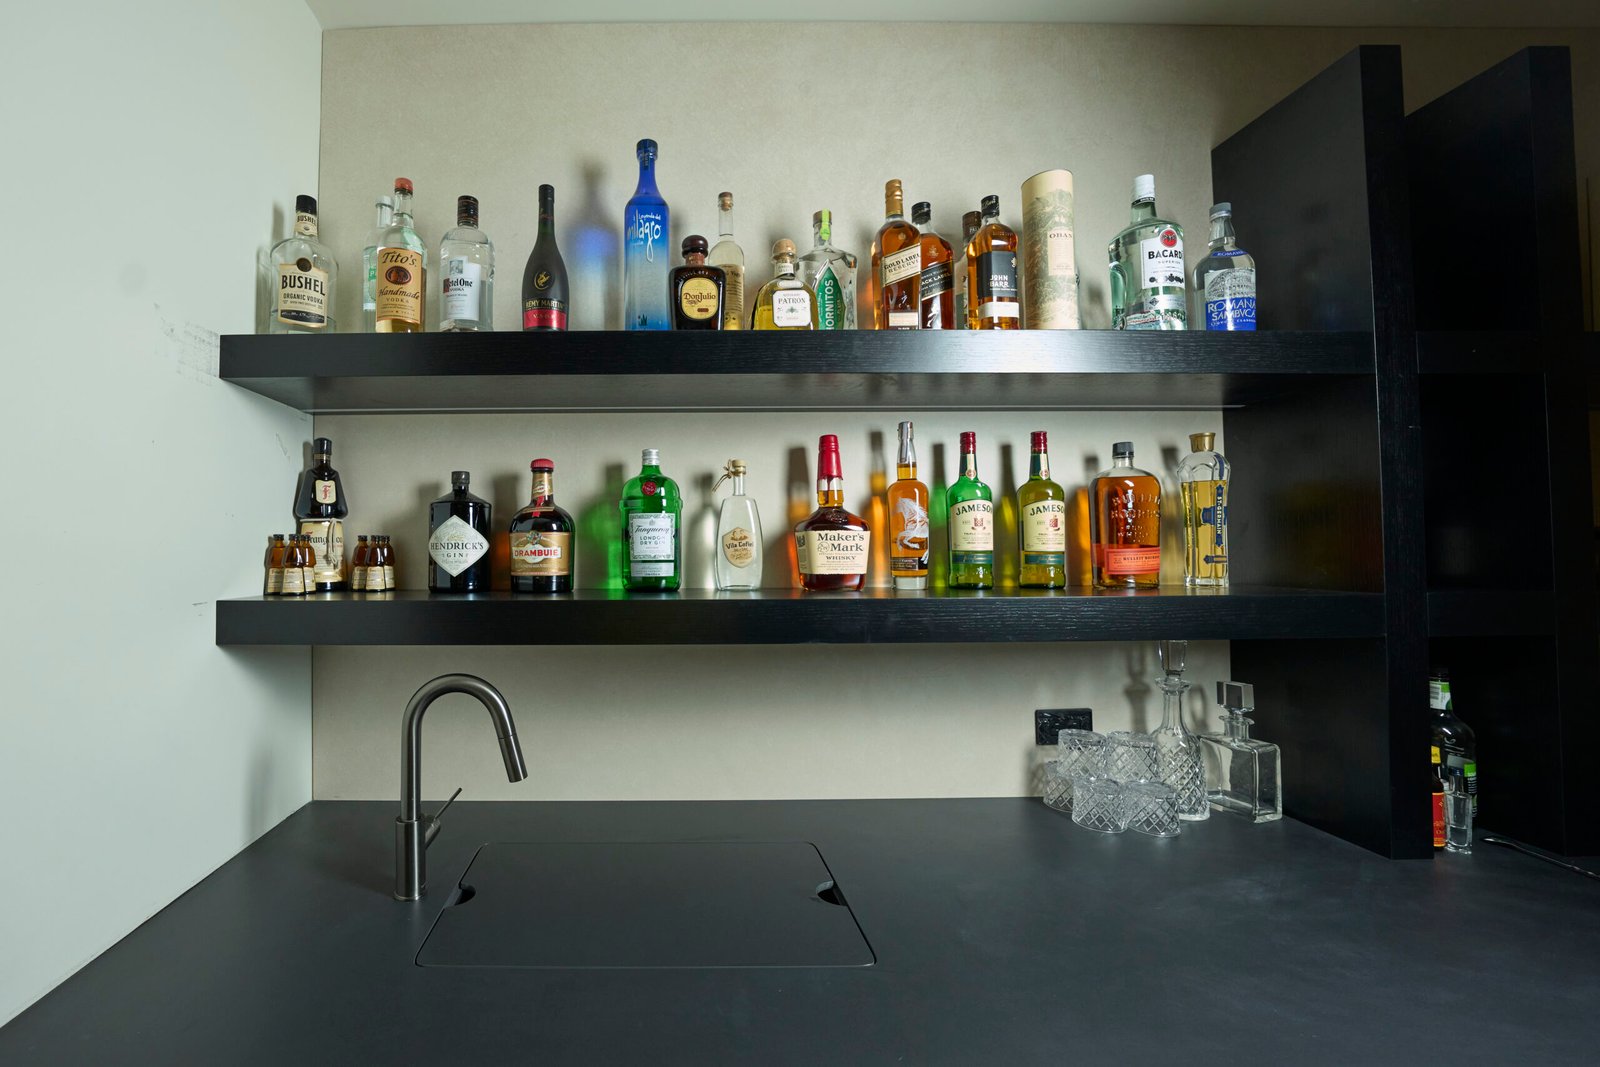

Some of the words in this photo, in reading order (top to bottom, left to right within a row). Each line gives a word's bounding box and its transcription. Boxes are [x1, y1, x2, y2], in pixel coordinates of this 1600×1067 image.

[883, 260, 901, 270] GOLD
[281, 274, 326, 296] BUSHEL
[459, 278, 473, 288] One
[379, 286, 420, 300] Handmade
[283, 293, 306, 301] ORGANIC
[307, 295, 324, 305] VODKA
[956, 503, 994, 516] JAMESO
[1030, 504, 1064, 516] JAMESO
[634, 526, 670, 535] Tanqueray
[817, 533, 864, 542] Maker's
[430, 542, 484, 551] HENDRICK'S
[831, 543, 864, 552] Mark
